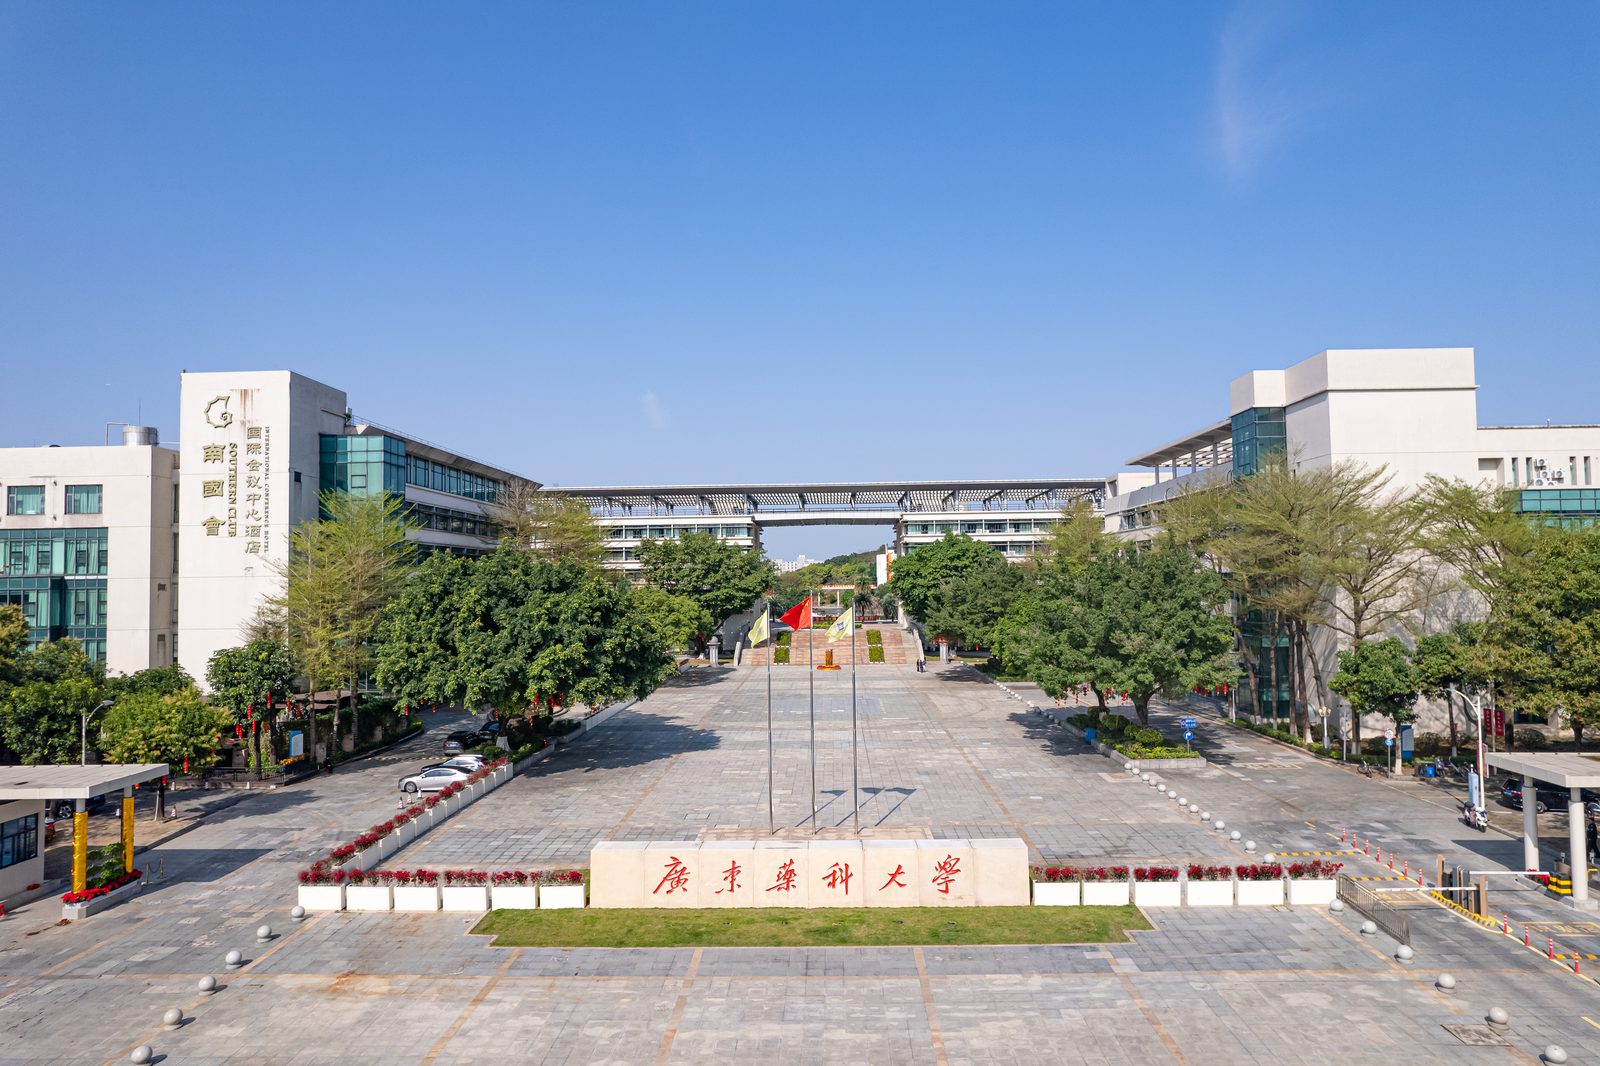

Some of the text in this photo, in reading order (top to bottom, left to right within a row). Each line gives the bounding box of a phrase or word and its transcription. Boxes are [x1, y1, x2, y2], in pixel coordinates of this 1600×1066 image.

[202, 442, 226, 536] 南國會
[227, 442, 238, 538] SOUTHERN CLUB
[245, 426, 262, 554] 国际会议中心酒店
